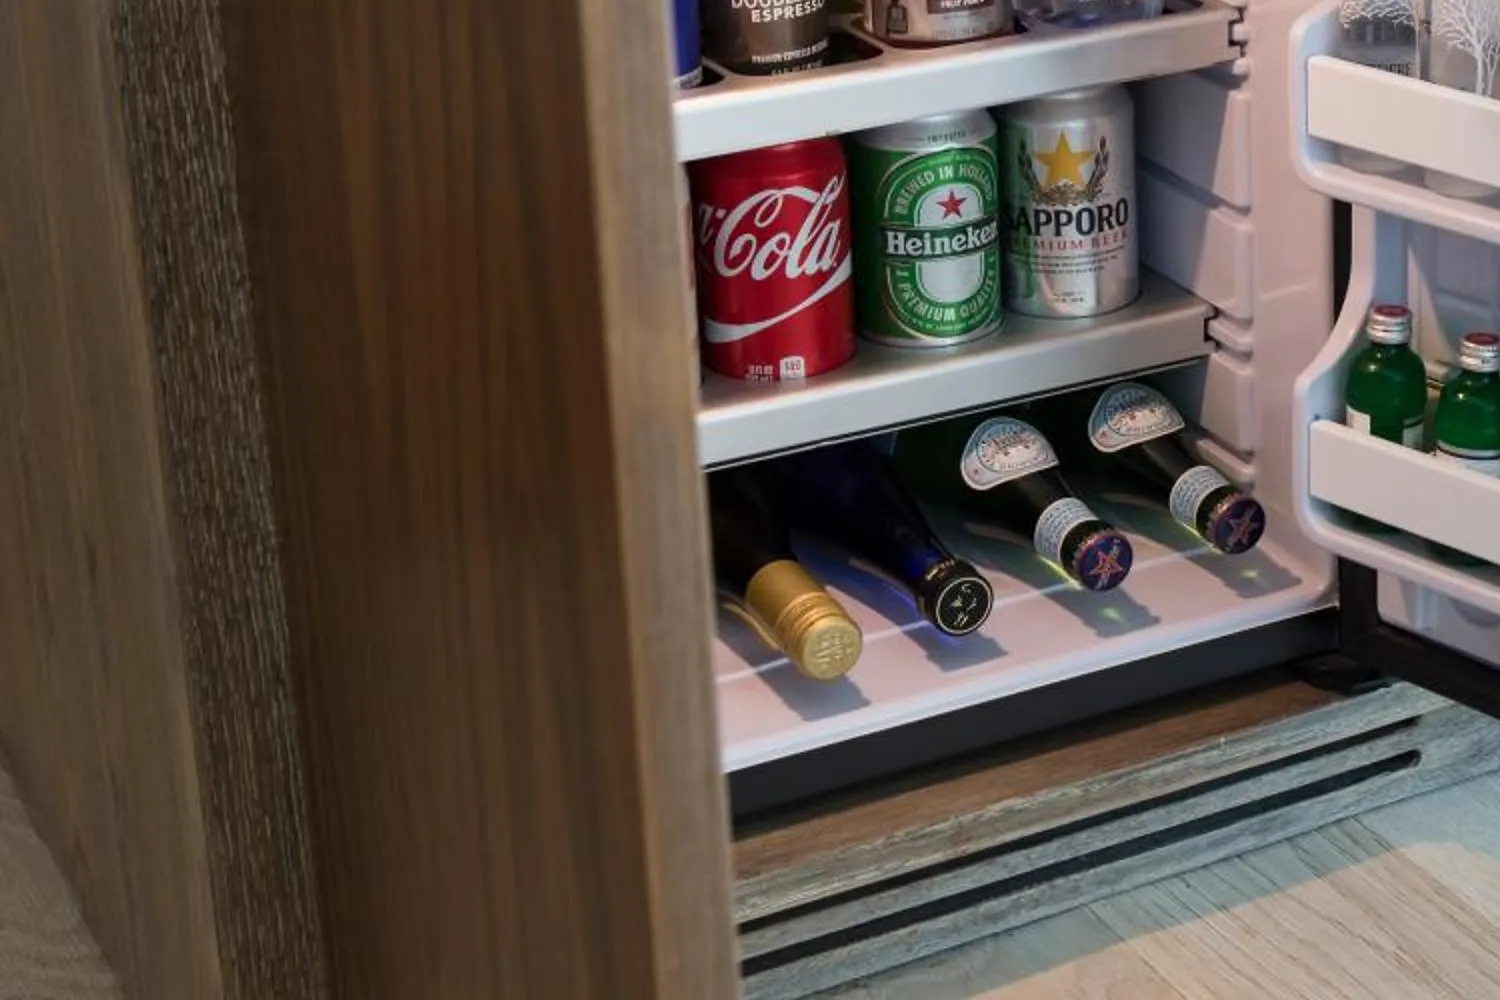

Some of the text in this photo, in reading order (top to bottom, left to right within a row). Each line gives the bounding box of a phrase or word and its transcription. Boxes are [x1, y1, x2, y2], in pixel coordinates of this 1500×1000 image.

[939, 165, 954, 180] IN
[886, 219, 998, 256] Heineken
[1012, 236, 1084, 254] EMIUM
